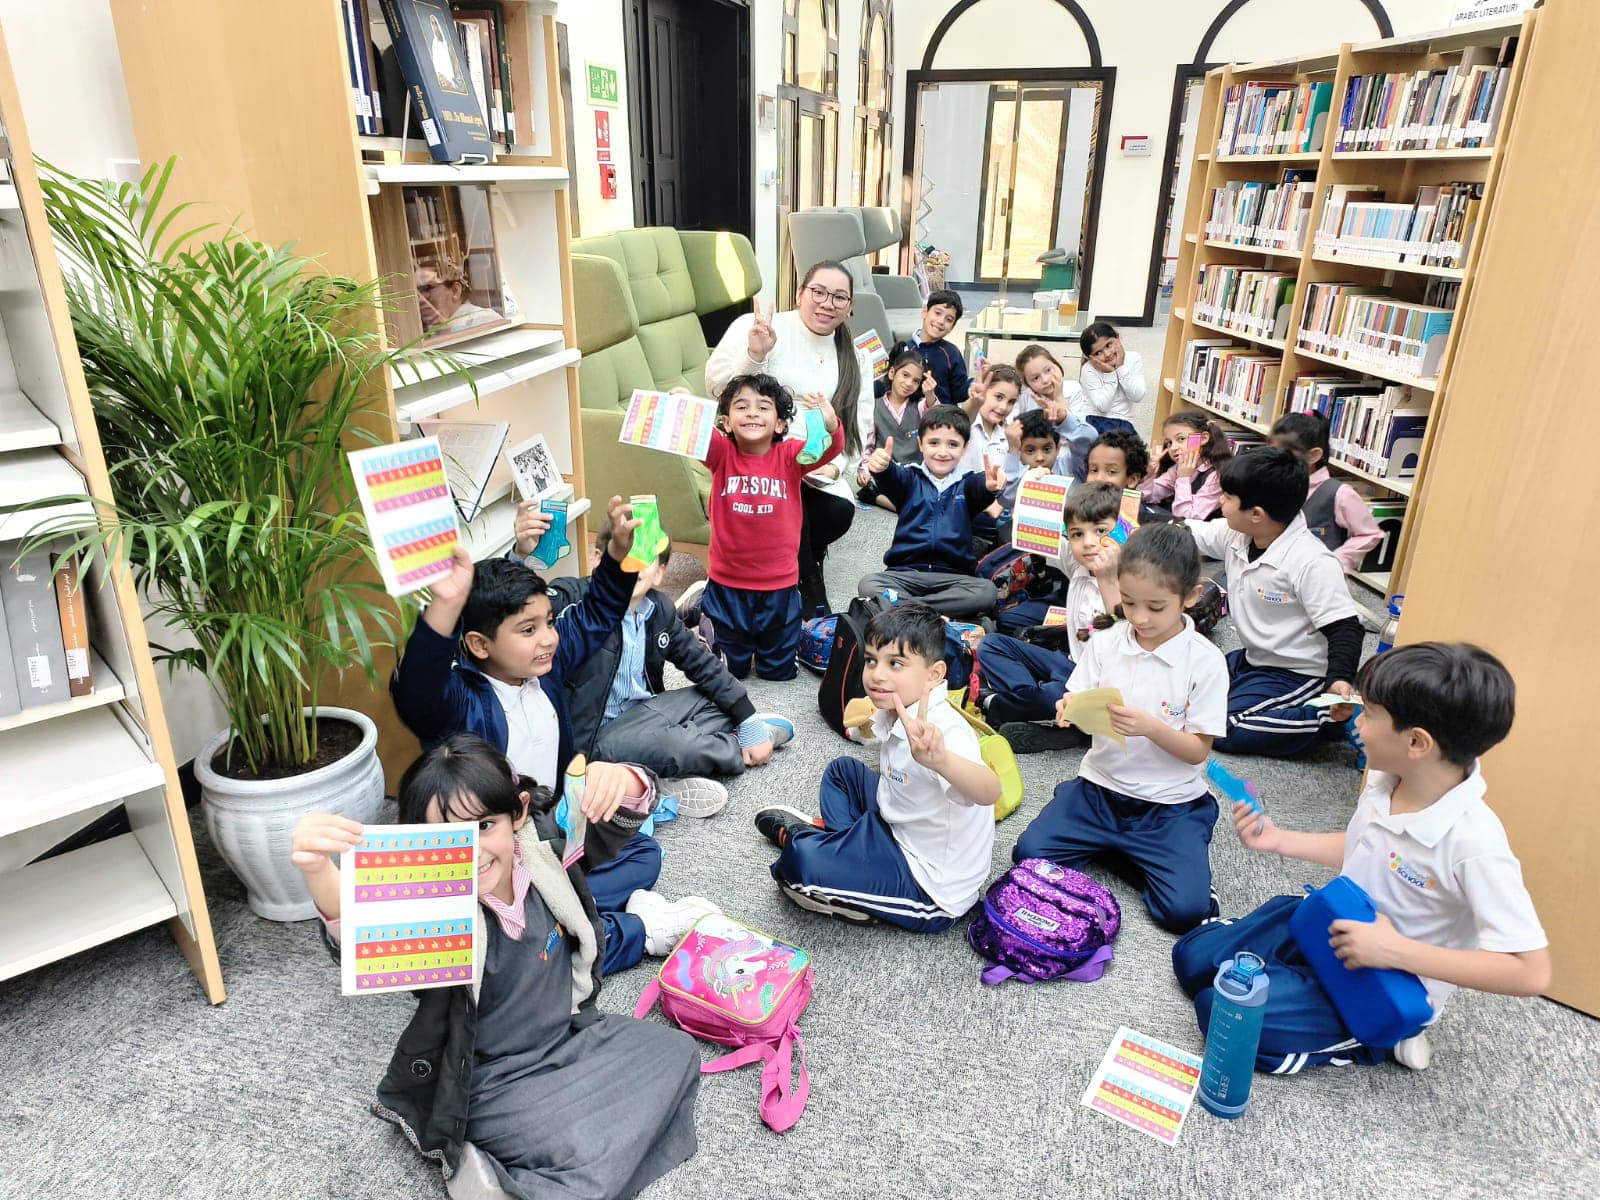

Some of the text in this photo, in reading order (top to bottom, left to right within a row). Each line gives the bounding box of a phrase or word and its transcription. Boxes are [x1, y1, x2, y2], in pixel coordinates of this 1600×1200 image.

[1455, 10, 1478, 21] ARABIC
[732, 501, 774, 515] COOL KID
